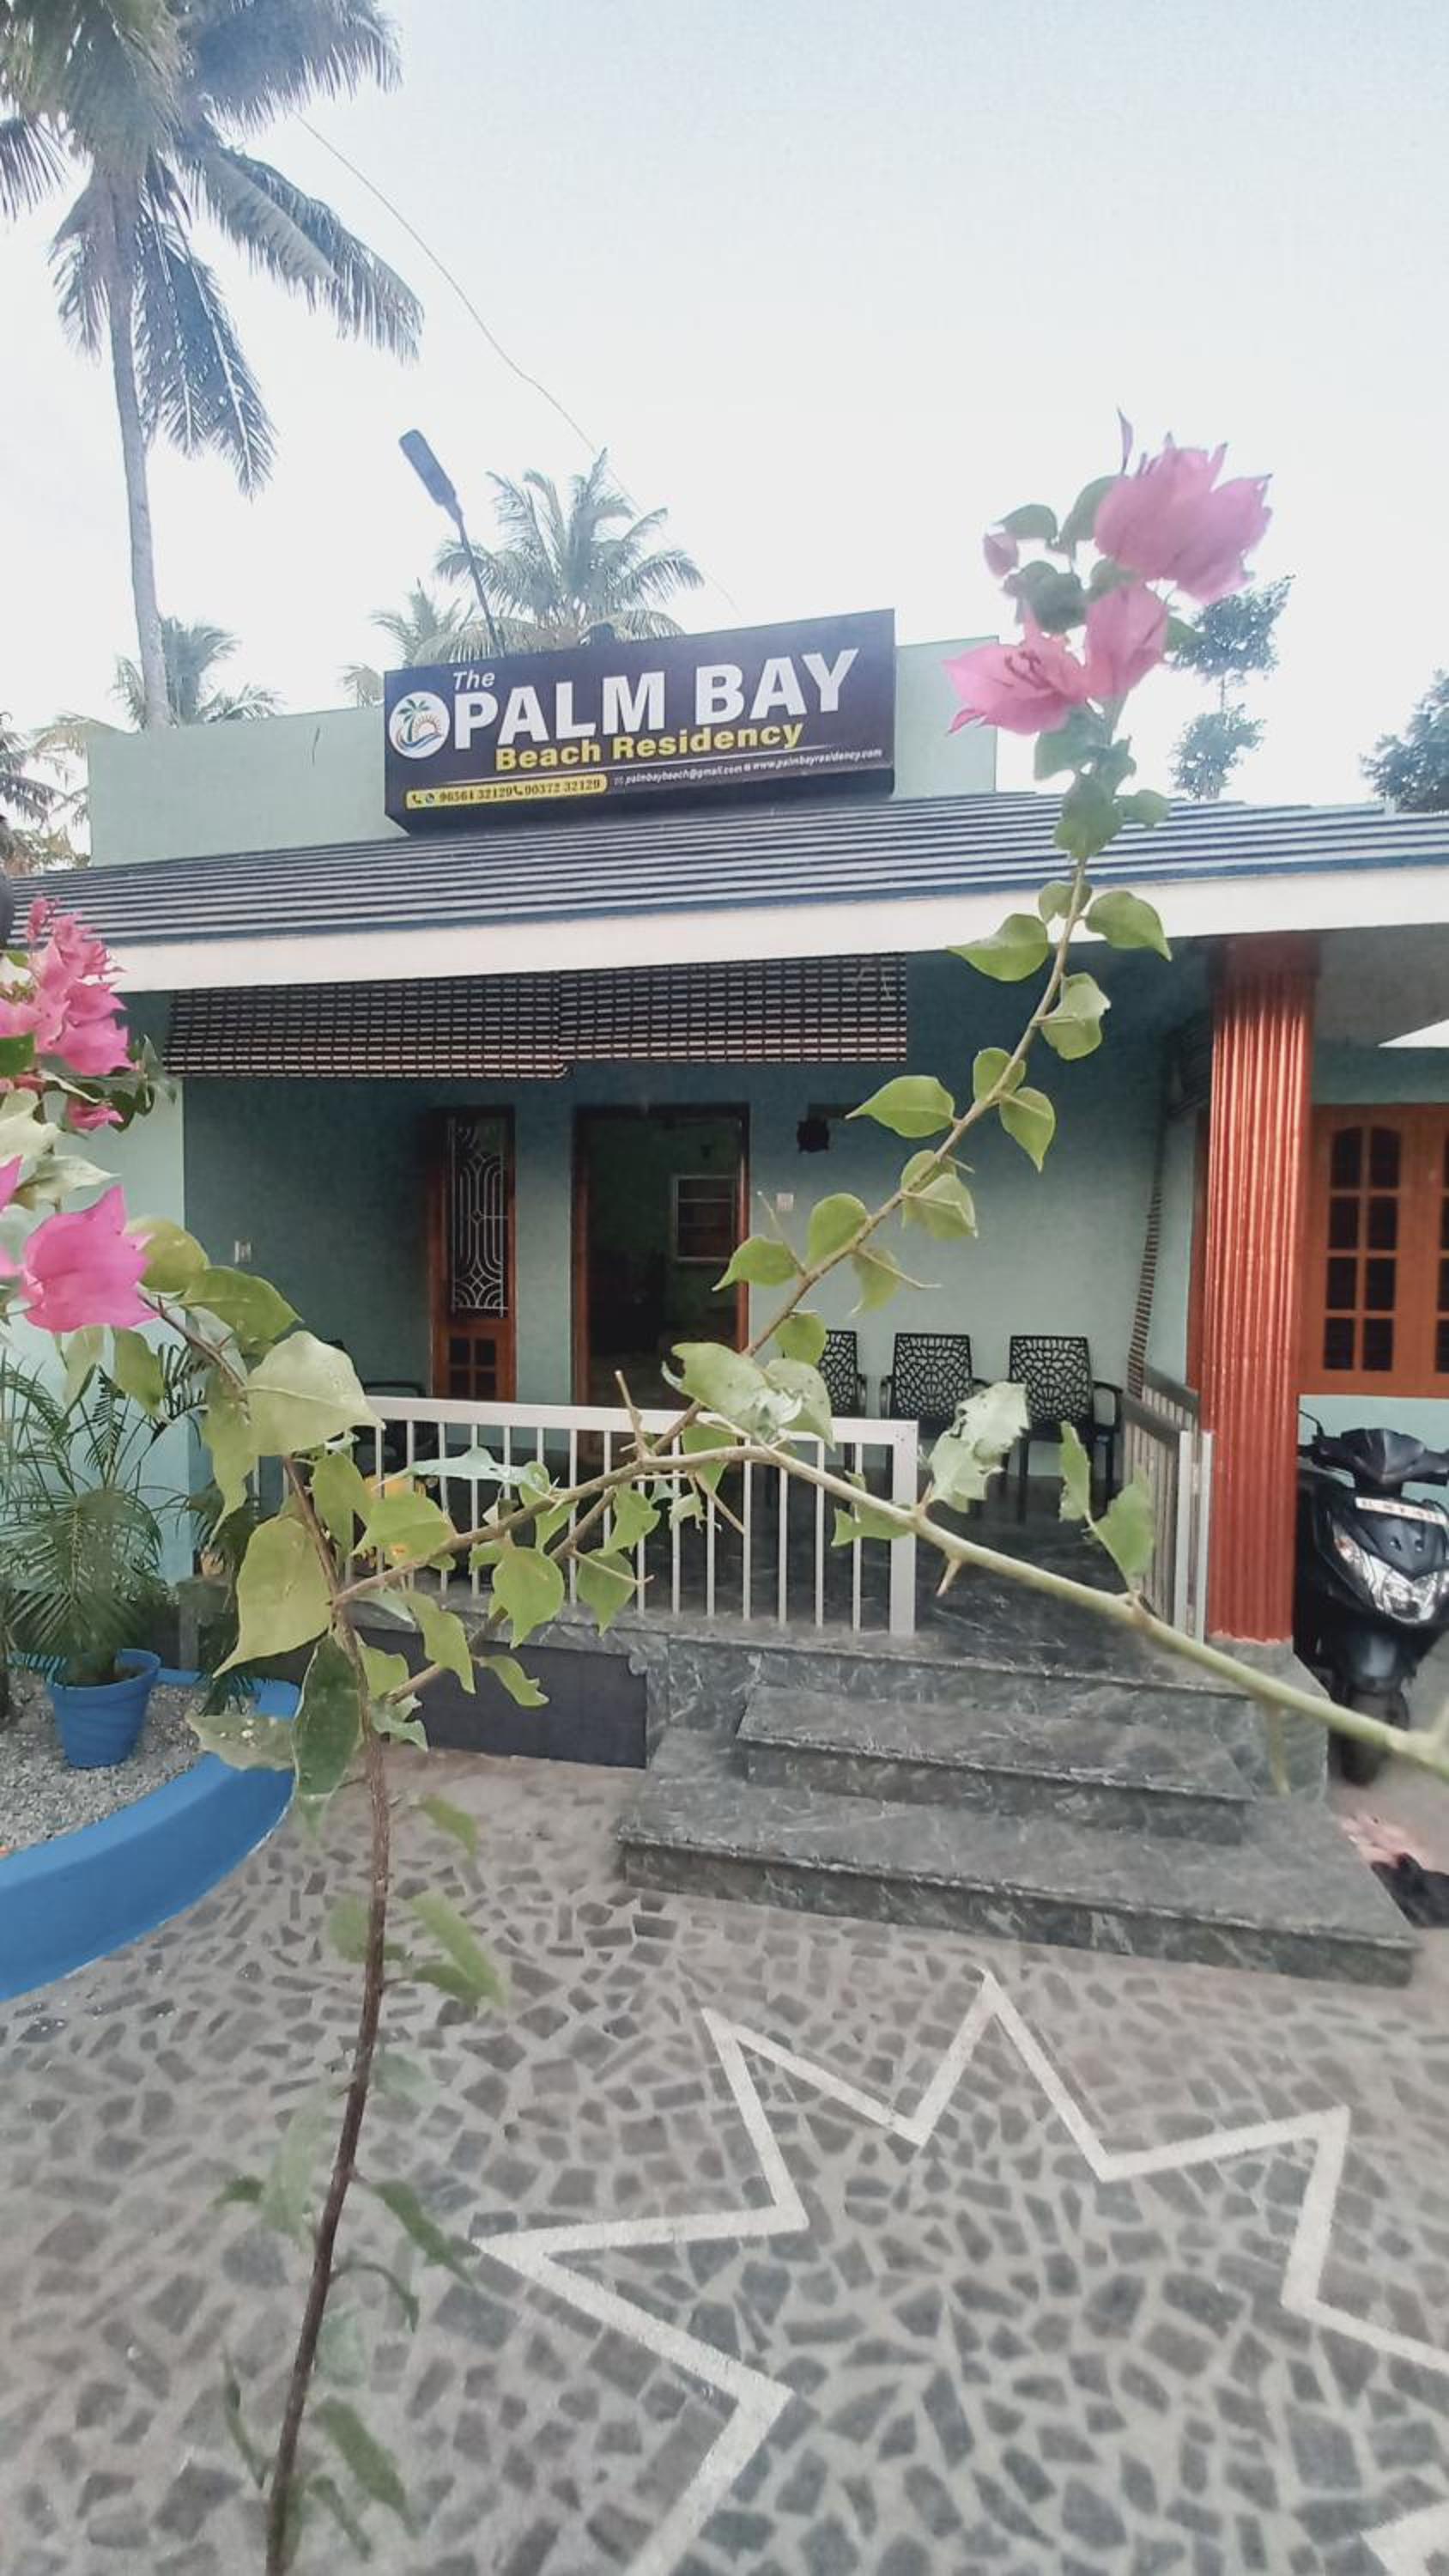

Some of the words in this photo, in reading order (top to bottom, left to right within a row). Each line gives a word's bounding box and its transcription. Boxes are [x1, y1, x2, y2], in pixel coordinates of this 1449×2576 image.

[452, 669, 495, 691] The
[454, 671, 665, 750] PALM
[695, 648, 858, 726] BAY
[495, 738, 601, 771] Beach
[612, 722, 804, 761] Residency
